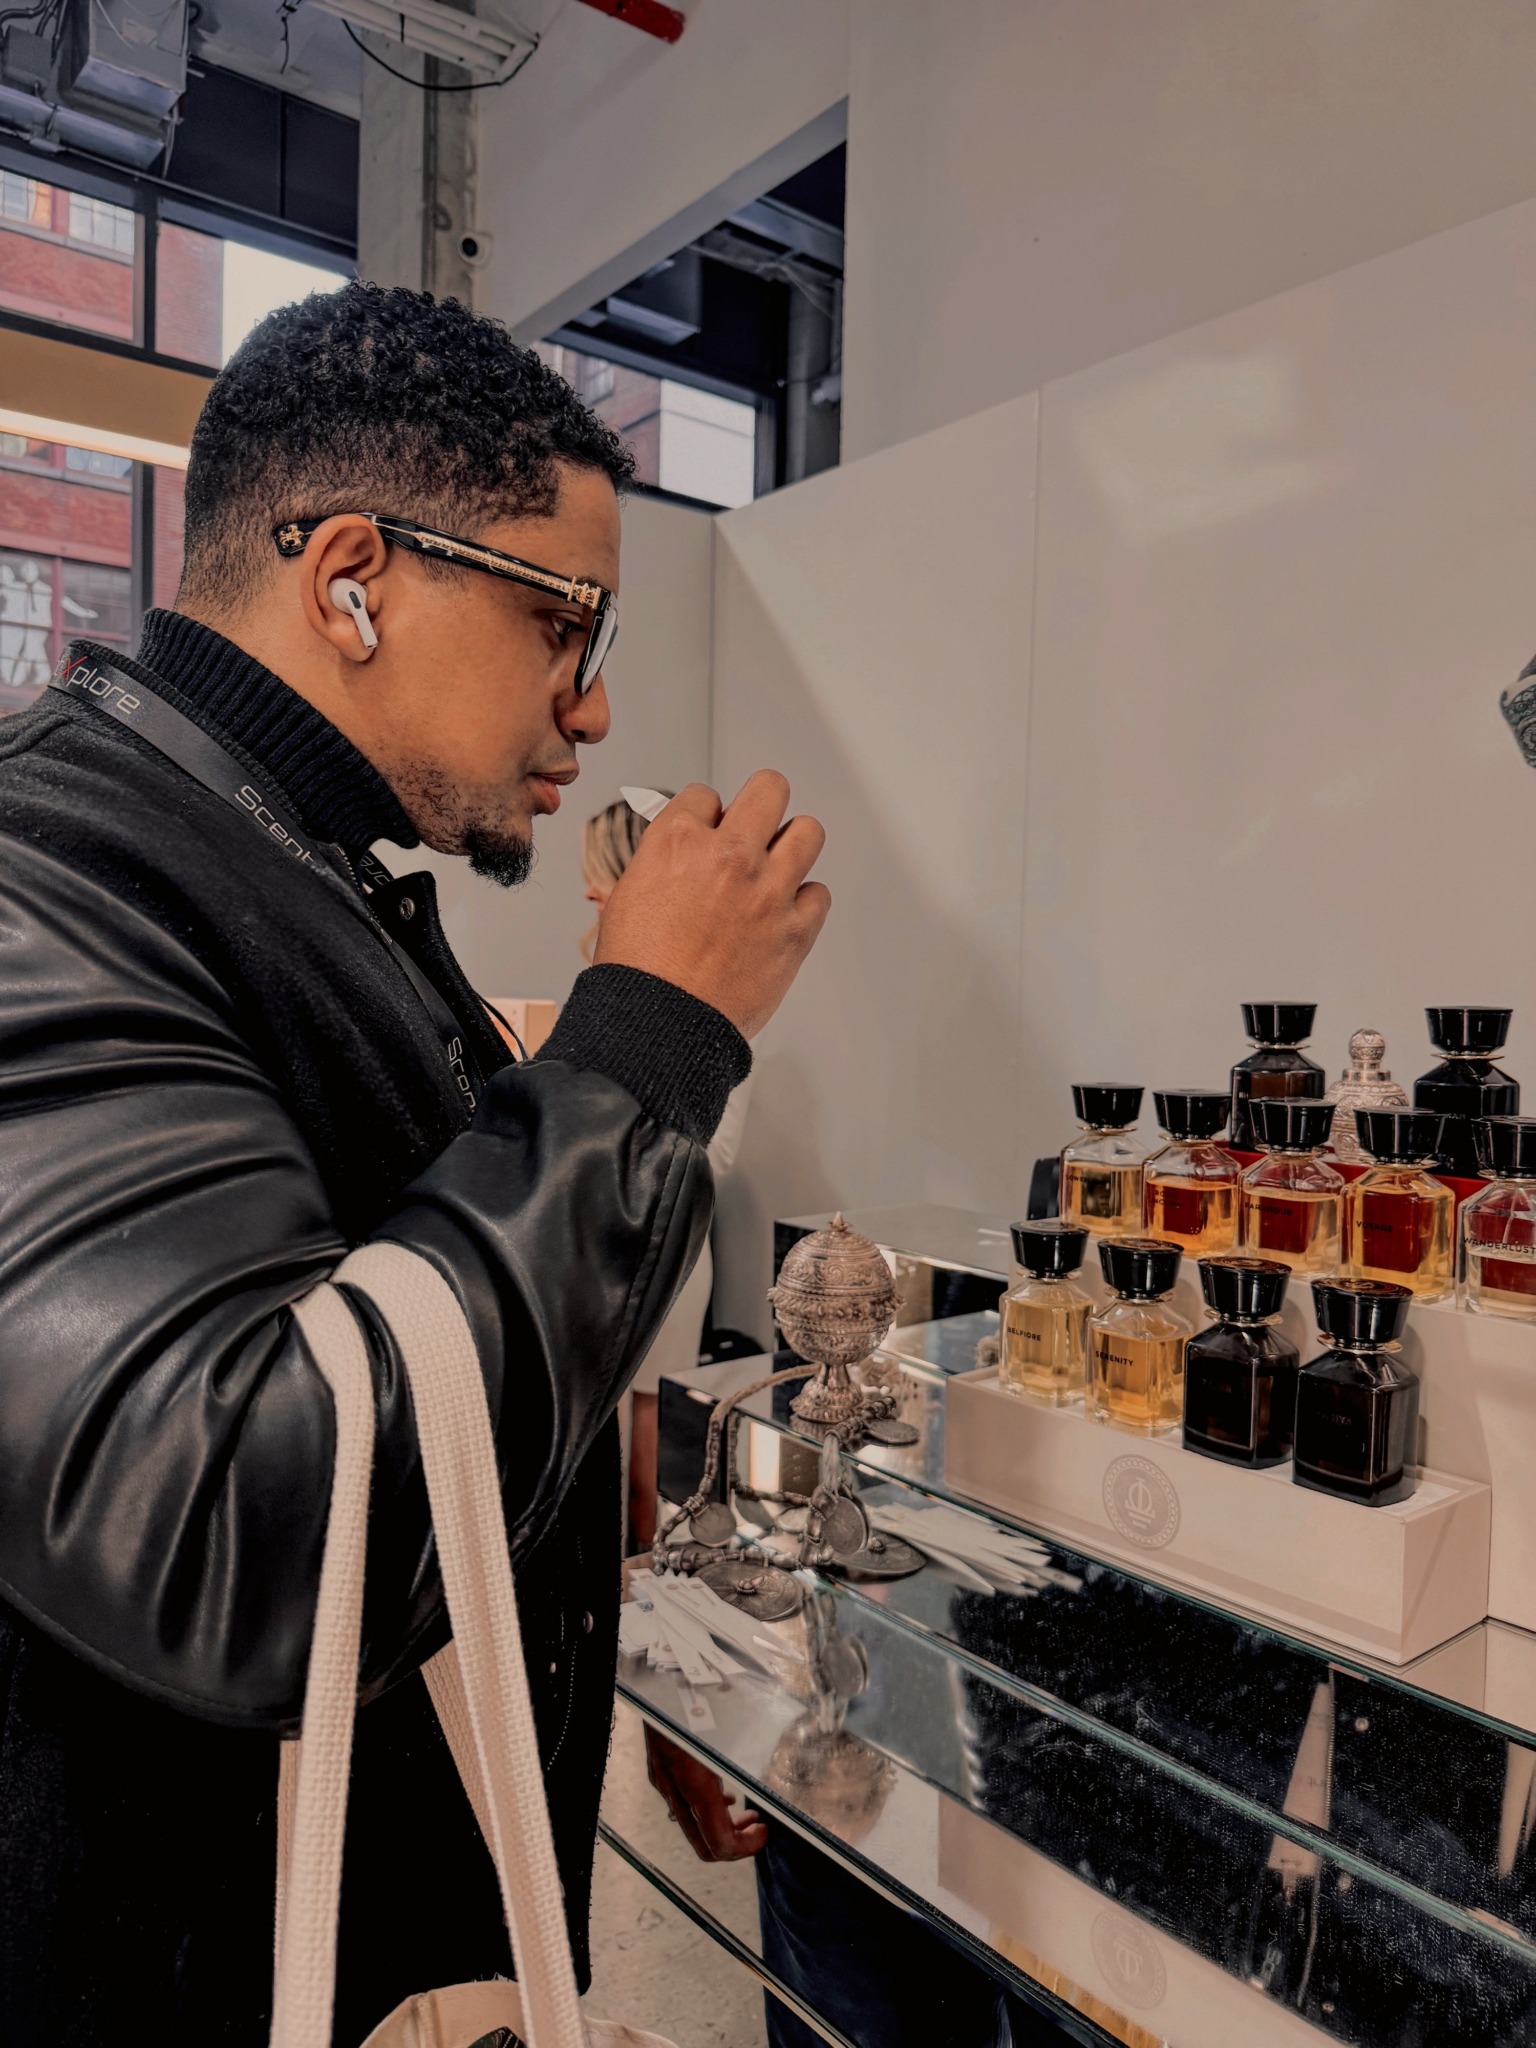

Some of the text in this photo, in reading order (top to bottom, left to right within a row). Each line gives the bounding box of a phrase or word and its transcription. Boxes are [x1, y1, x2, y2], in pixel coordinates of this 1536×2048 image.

[1356, 1220, 1393, 1233] VOYAGE
[1463, 1237, 1536, 1254] WANDERLUST
[1007, 1326, 1041, 1342] BELFIORE
[1095, 1350, 1134, 1367] SERENITY
